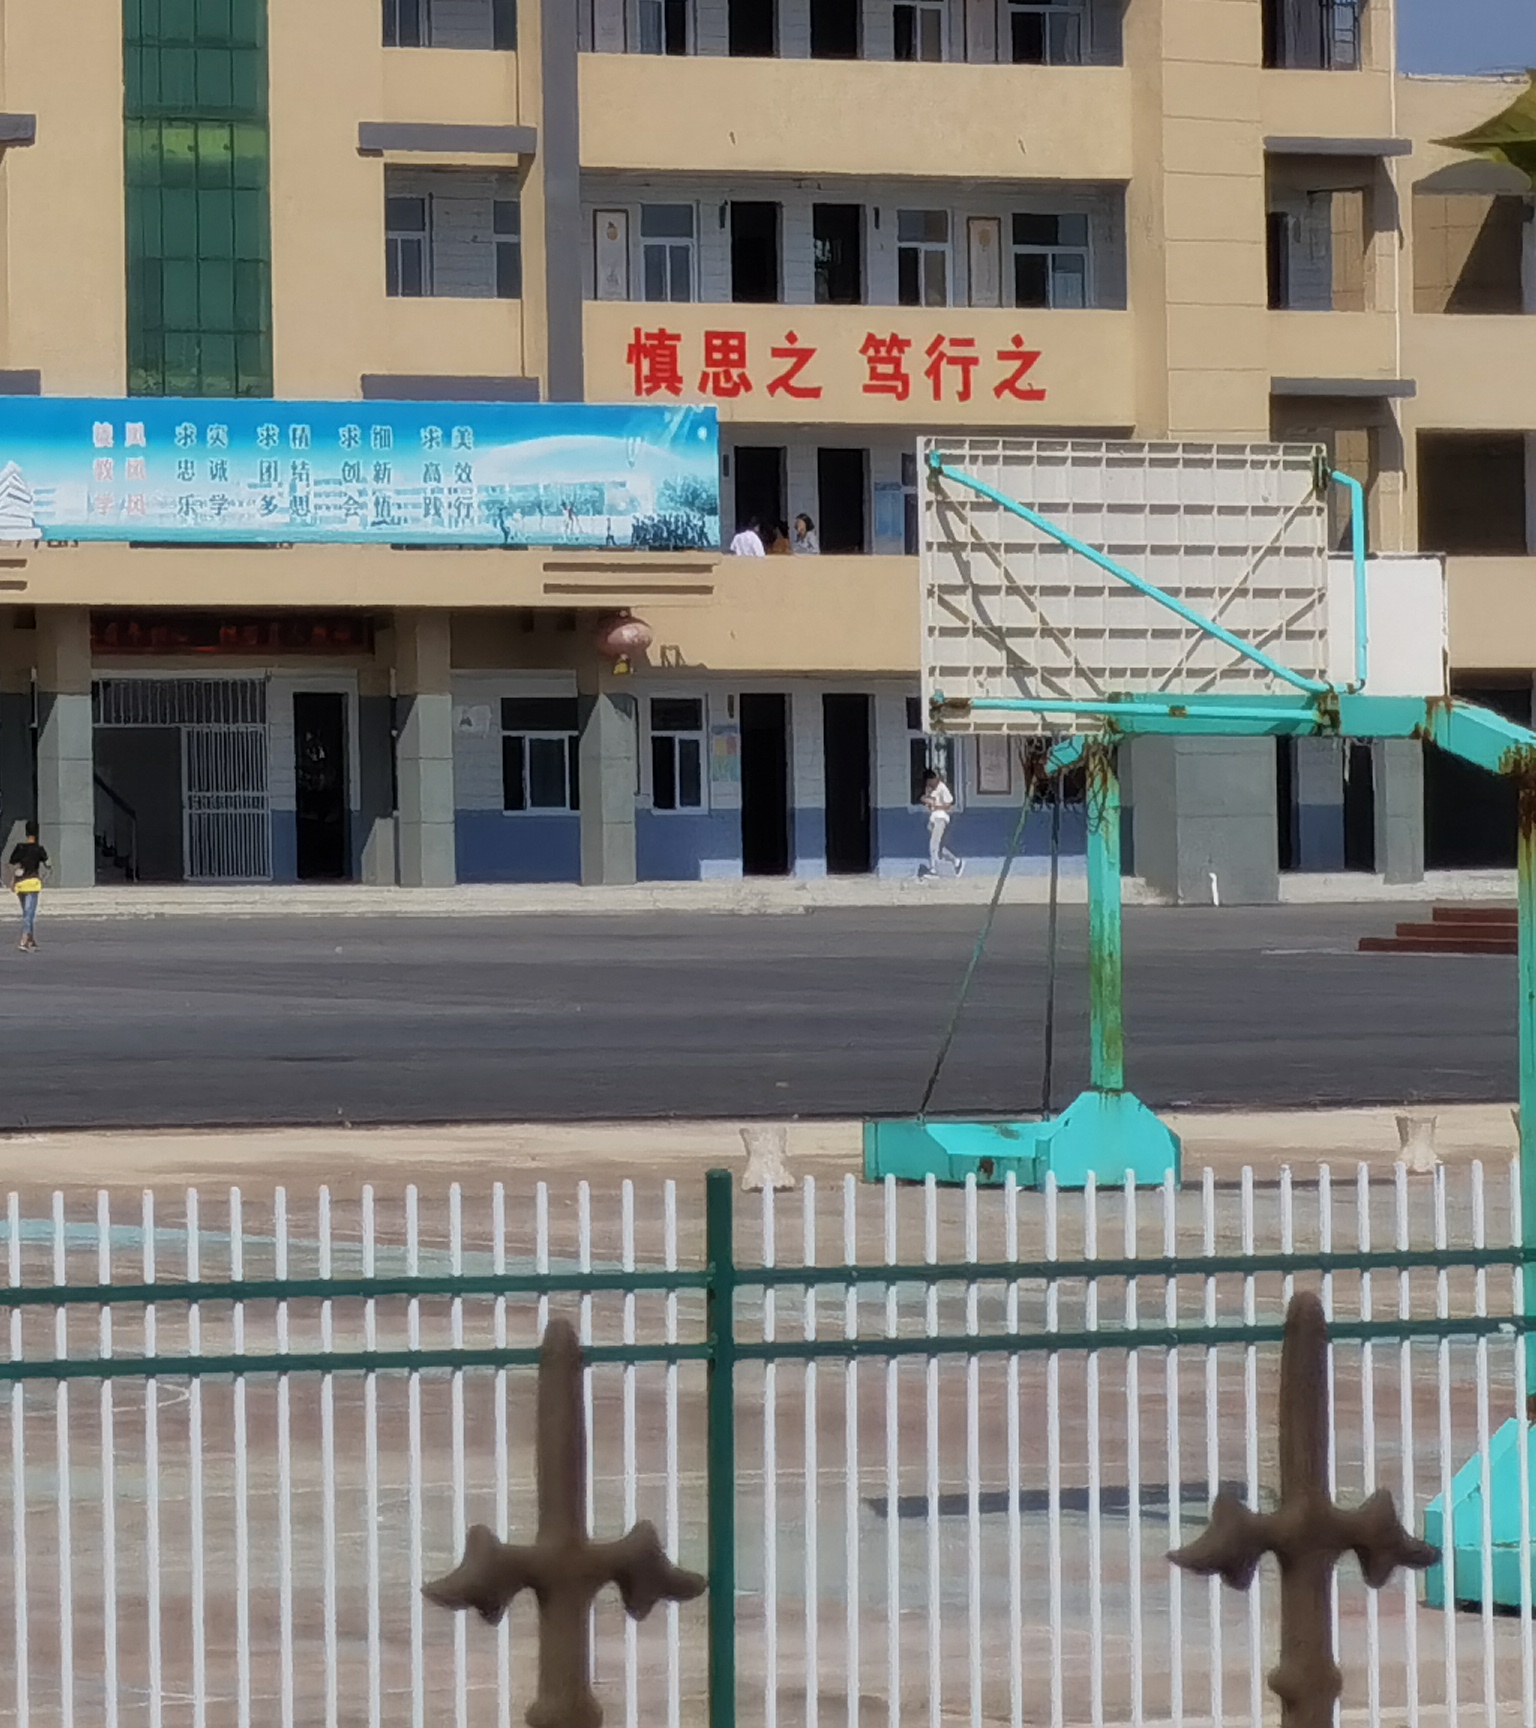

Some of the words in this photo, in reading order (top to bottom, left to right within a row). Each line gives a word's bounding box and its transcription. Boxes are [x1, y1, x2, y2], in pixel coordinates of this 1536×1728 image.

[626, 327, 823, 399] 慎思之
[858, 332, 1047, 402] 笃行之
[175, 423, 228, 449] 求实
[257, 423, 311, 450] 求精
[177, 458, 228, 482] 忠诚
[258, 459, 311, 484] 团结
[341, 459, 392, 484] 创新
[422, 460, 475, 485] 高效
[177, 493, 228, 517] 乐学
